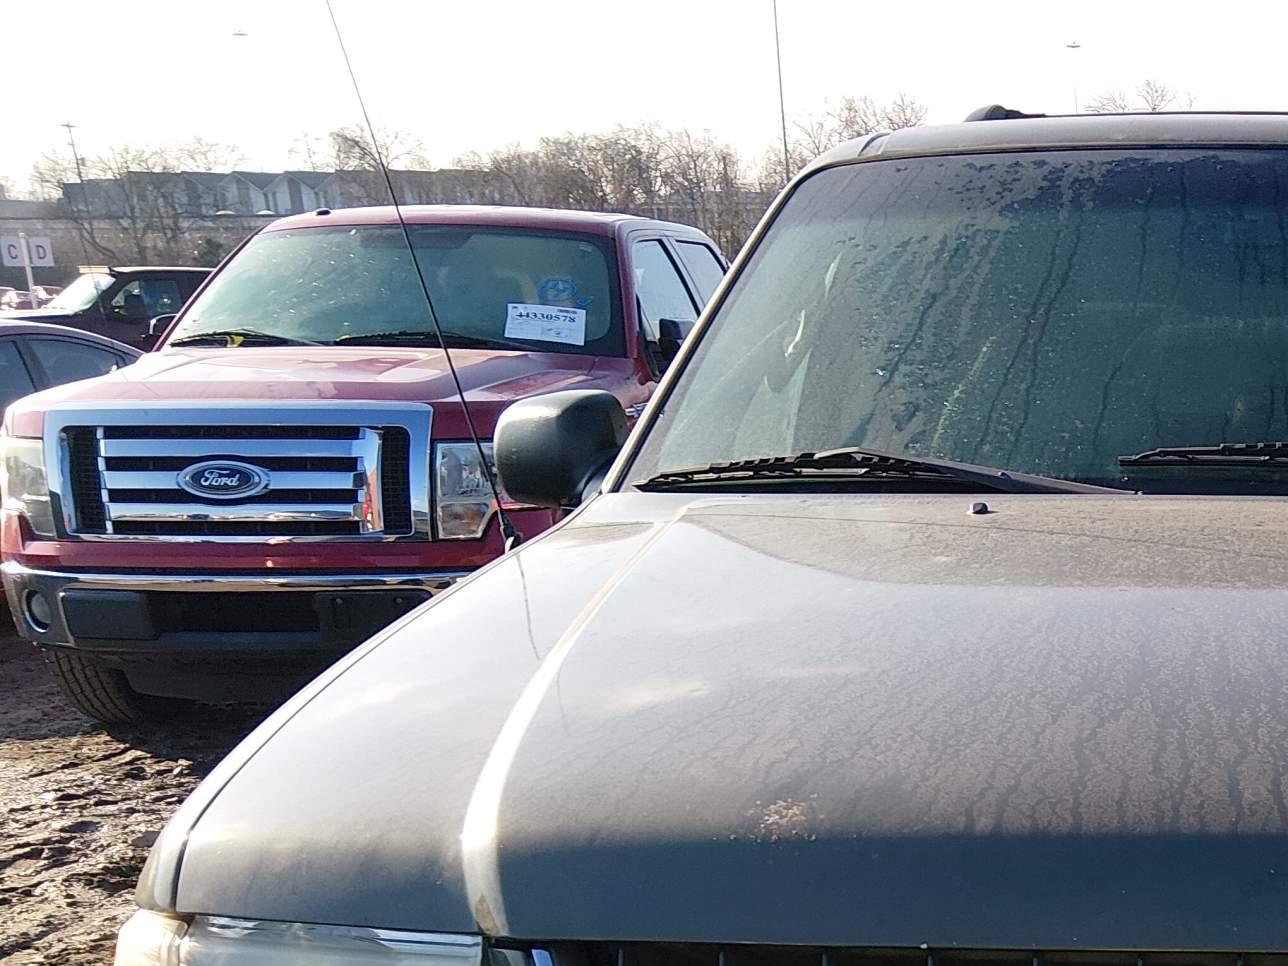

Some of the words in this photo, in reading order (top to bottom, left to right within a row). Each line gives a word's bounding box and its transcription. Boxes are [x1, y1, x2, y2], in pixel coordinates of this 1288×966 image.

[8, 244, 18, 260] C
[36, 245, 48, 260] D
[515, 311, 577, 323] 44330578
[200, 469, 240, 486] Ford
